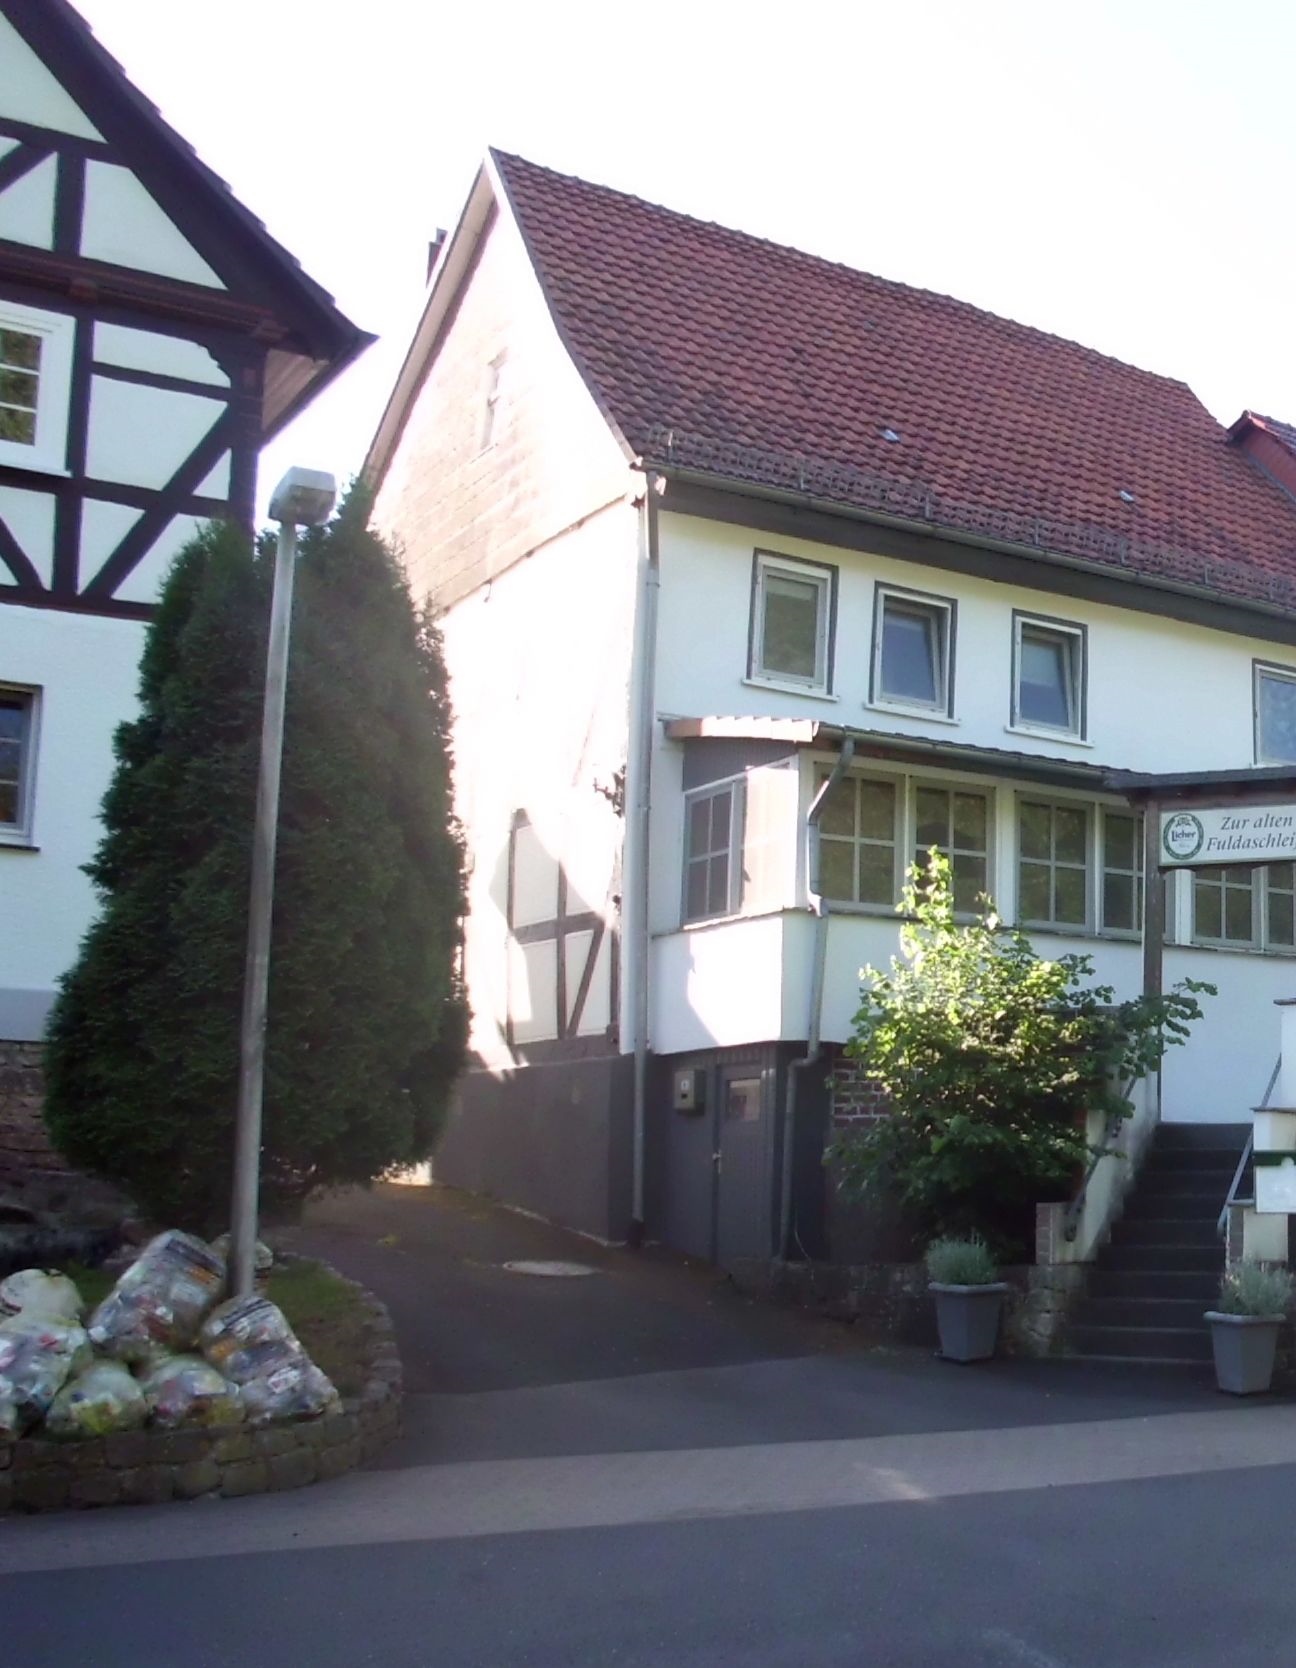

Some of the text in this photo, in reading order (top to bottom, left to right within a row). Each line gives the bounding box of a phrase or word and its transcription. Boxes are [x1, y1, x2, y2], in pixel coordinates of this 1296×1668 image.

[1221, 813, 1293, 830] Zur alten
[1171, 829, 1197, 842] Licher
